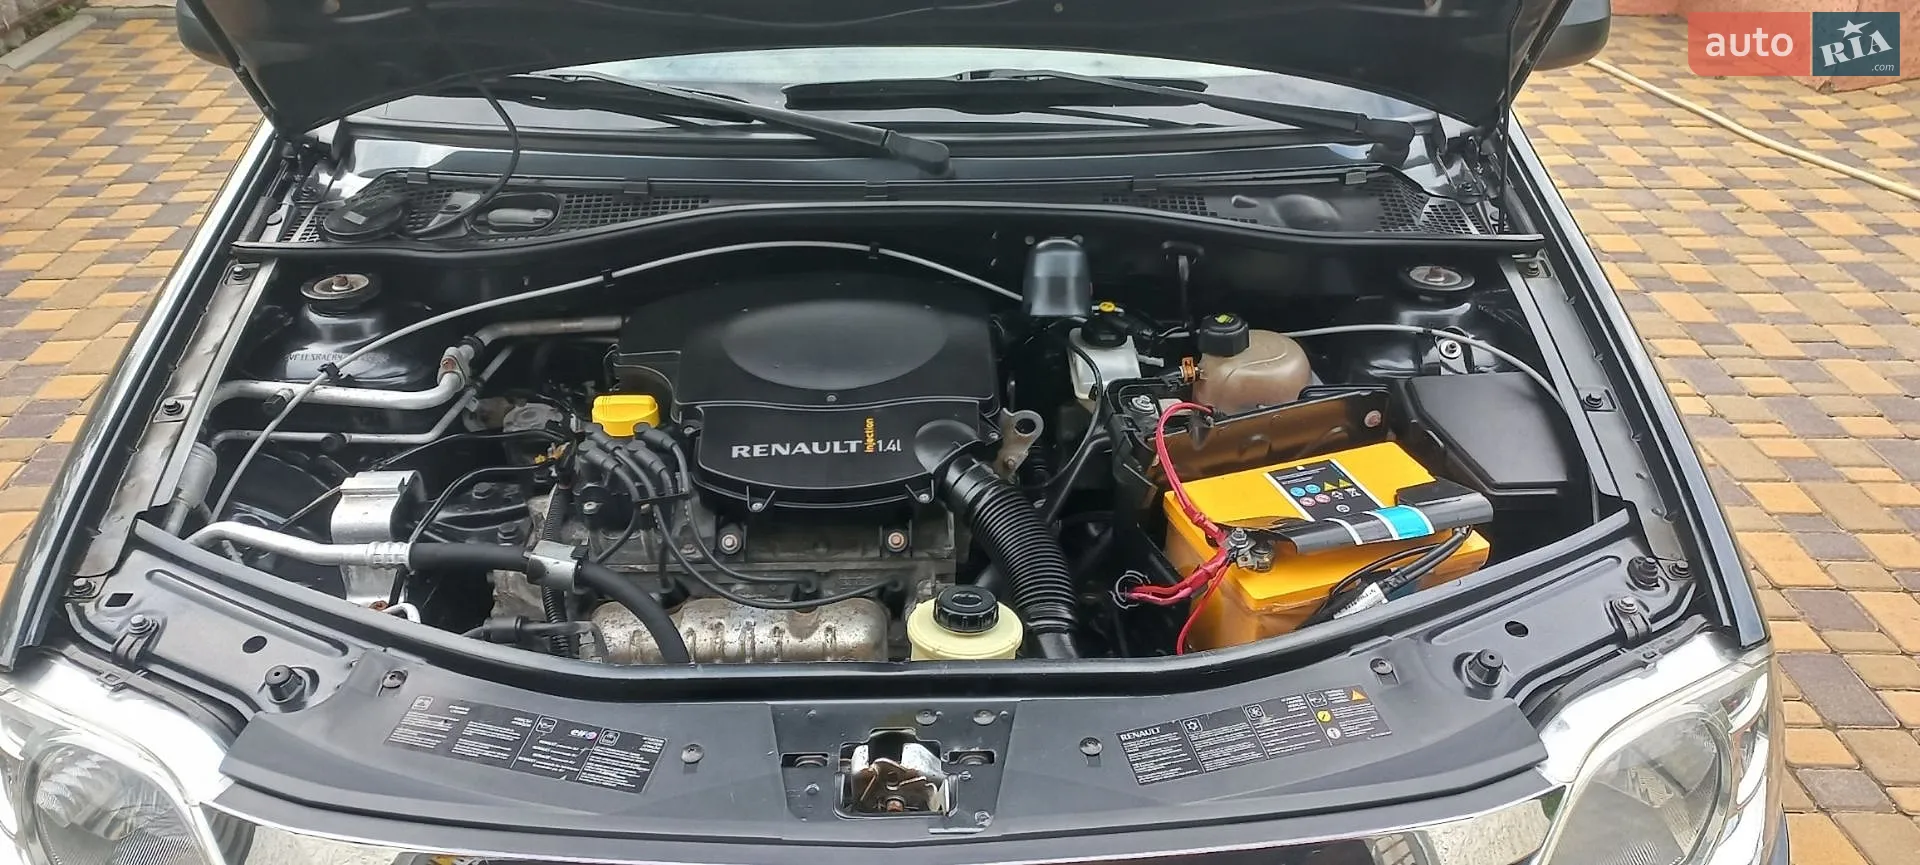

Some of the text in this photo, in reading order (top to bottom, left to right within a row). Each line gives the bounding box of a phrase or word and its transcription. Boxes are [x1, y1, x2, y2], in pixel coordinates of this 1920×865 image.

[731, 440, 862, 458] RENAULT
[569, 728, 587, 737] elf
[1119, 726, 1161, 742] RENAULT
